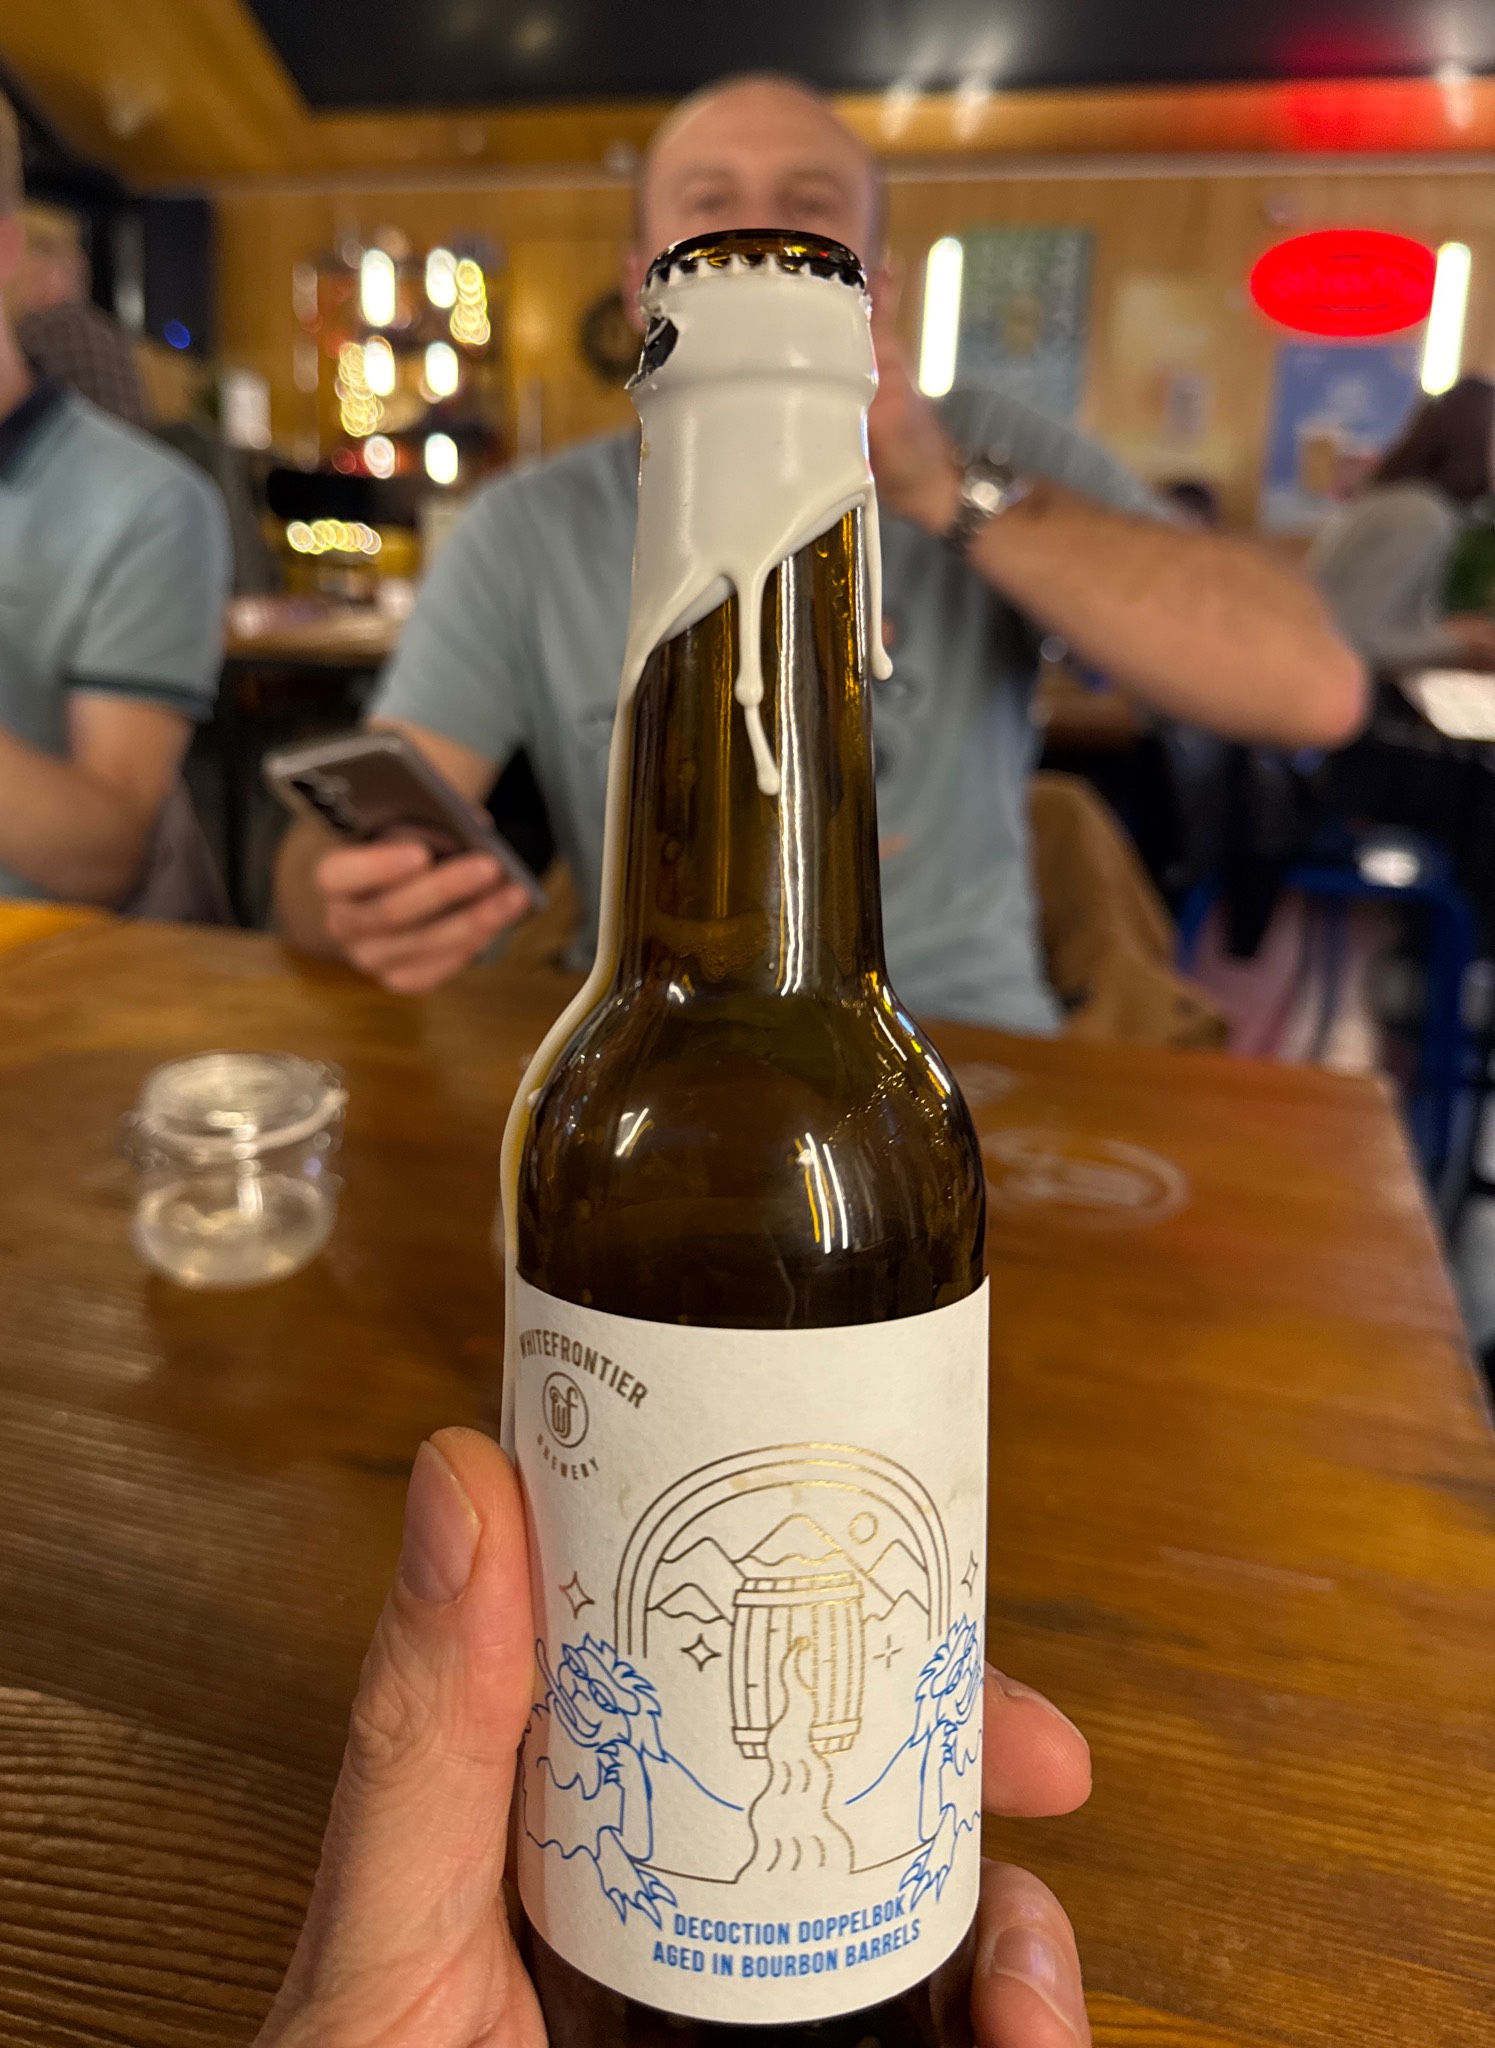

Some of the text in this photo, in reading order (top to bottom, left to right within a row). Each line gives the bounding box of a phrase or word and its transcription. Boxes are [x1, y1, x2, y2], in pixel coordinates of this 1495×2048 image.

[519, 1329, 648, 1408] WHITEFRONTIER
[537, 1433, 600, 1480] BREWERY
[674, 1893, 906, 1945] DECOCTION DOPPELBOK
[653, 1918, 921, 1978] AGED IN BOURBON BARRELS
